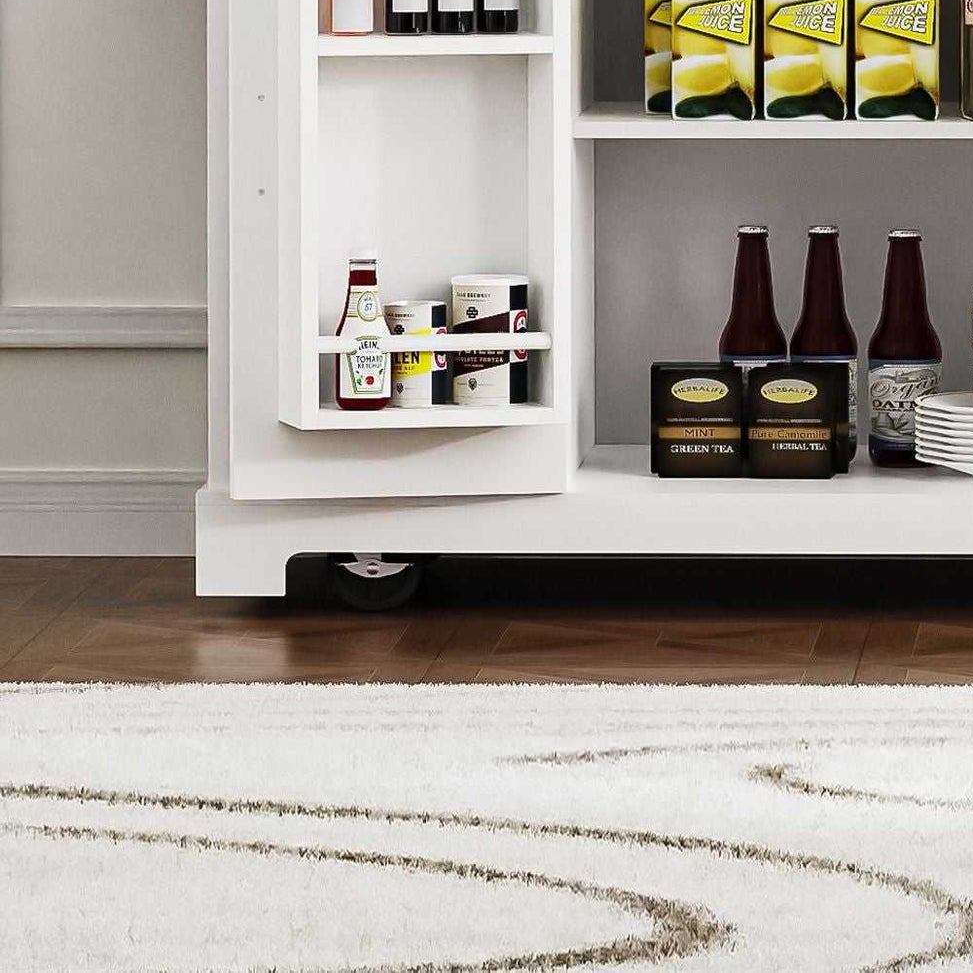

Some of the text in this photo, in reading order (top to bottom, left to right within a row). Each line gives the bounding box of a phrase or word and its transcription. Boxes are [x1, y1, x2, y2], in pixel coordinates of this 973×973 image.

[697, 14, 744, 33] JUICE
[788, 14, 835, 33] JUICE
[879, 14, 926, 33] JUICE
[684, 428, 715, 437] MINT
[751, 429, 774, 438] Pure
[670, 444, 734, 453] GREEN TEA
